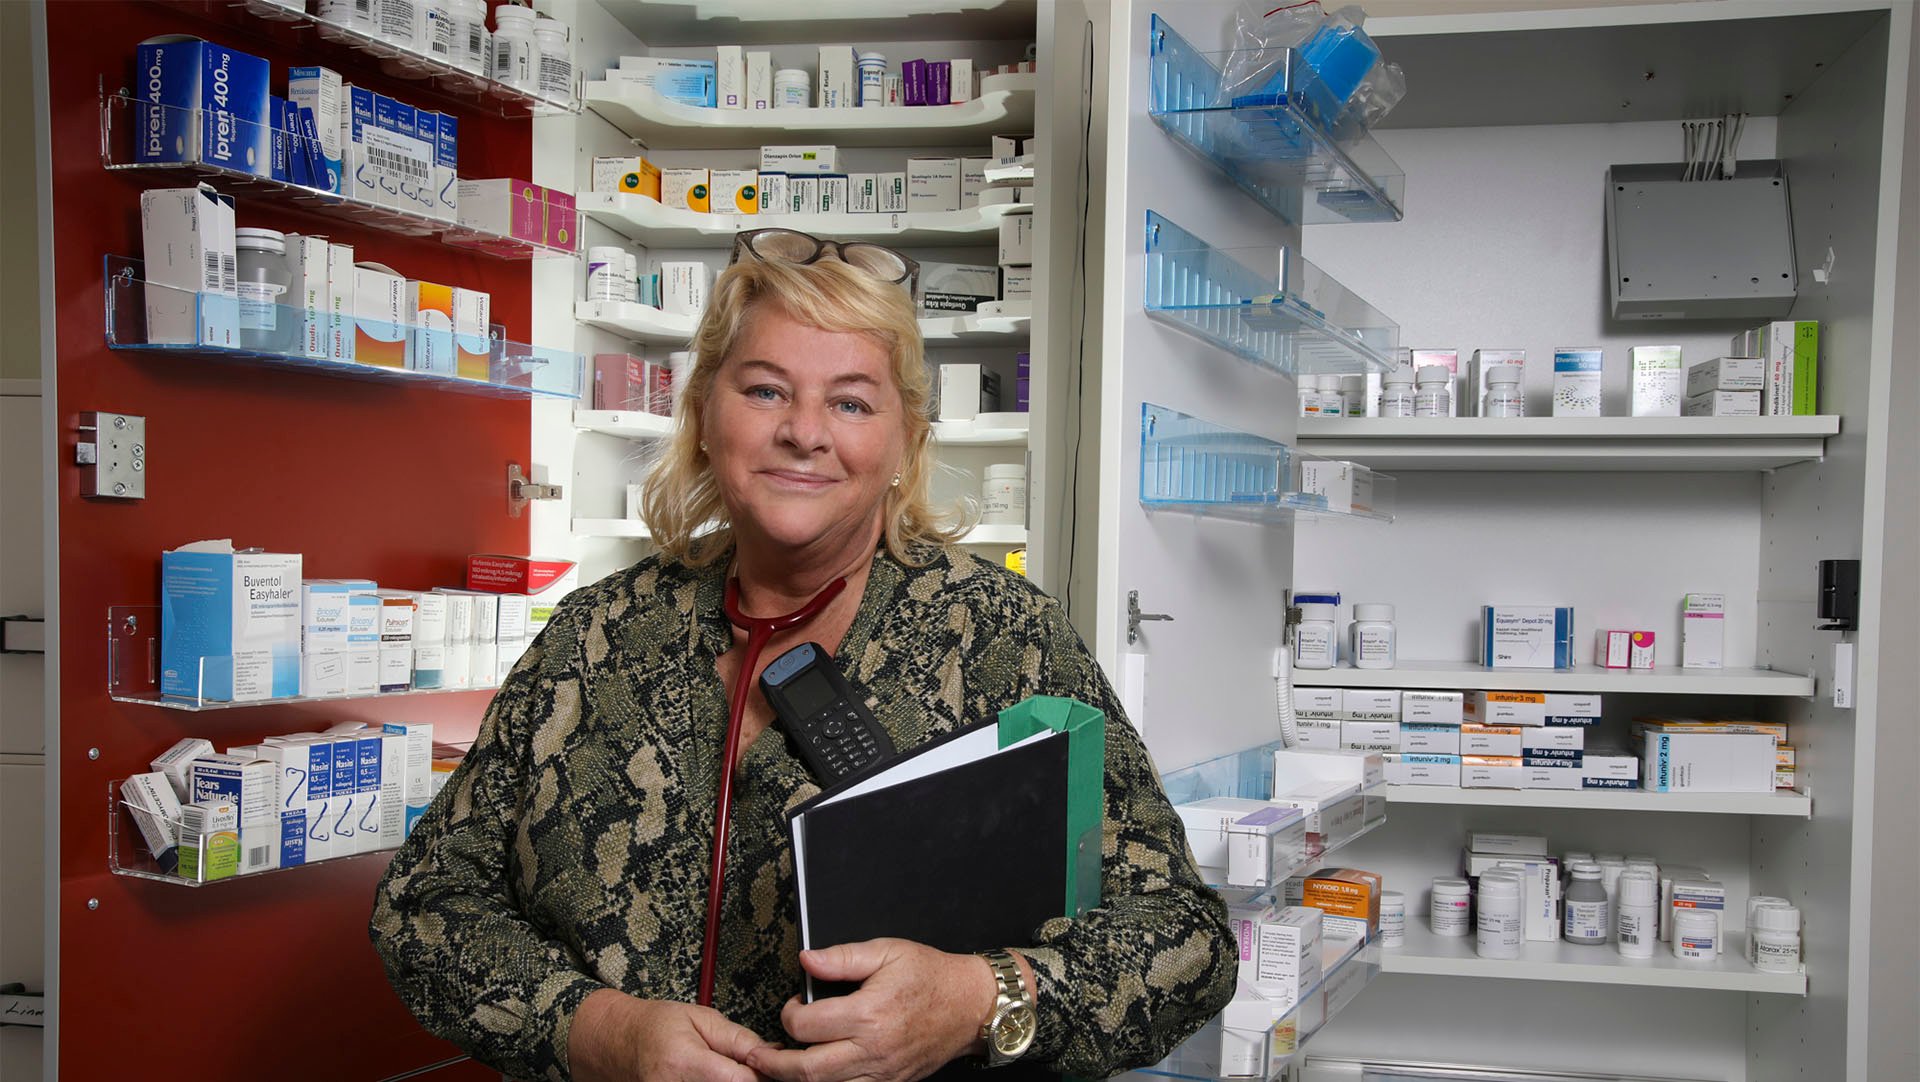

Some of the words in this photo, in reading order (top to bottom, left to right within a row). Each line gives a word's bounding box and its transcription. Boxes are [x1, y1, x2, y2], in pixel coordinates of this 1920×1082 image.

[154, 48, 164, 66] mg
[221, 53, 231, 71] mg
[149, 66, 161, 103] 400
[214, 69, 229, 107] 400
[354, 106, 372, 118] Nasin
[287, 112, 296, 132] Ipren
[378, 113, 395, 125] Nasin
[148, 105, 162, 157] Ipren
[304, 120, 314, 140] Ipren
[397, 120, 414, 132] Nasin
[214, 110, 232, 161] Ipren
[419, 129, 435, 140] Nasin
[441, 131, 456, 143] Nasin
[309, 289, 316, 303] mg
[335, 296, 342, 310] mg
[925, 300, 939, 309] Krka
[939, 302, 967, 310] Quetiapin
[244, 575, 282, 588] Buventol
[250, 588, 292, 602] Easyhaler
[1367, 743, 1392, 751] intuniv
[360, 754, 378, 765] Nasin
[1409, 755, 1433, 763] intuniv
[1550, 750, 1574, 758] intuniv
[310, 762, 329, 773] Nasin
[335, 758, 354, 769] Nasin
[1659, 758, 1668, 787] intuniv
[195, 777, 220, 791] Tears
[196, 789, 239, 804] Naturale
[284, 837, 304, 849] Nasin
[1312, 883, 1340, 892] NYXOID
[1242, 921, 1250, 957] INDERAL
[1759, 944, 1780, 953] Atarax
